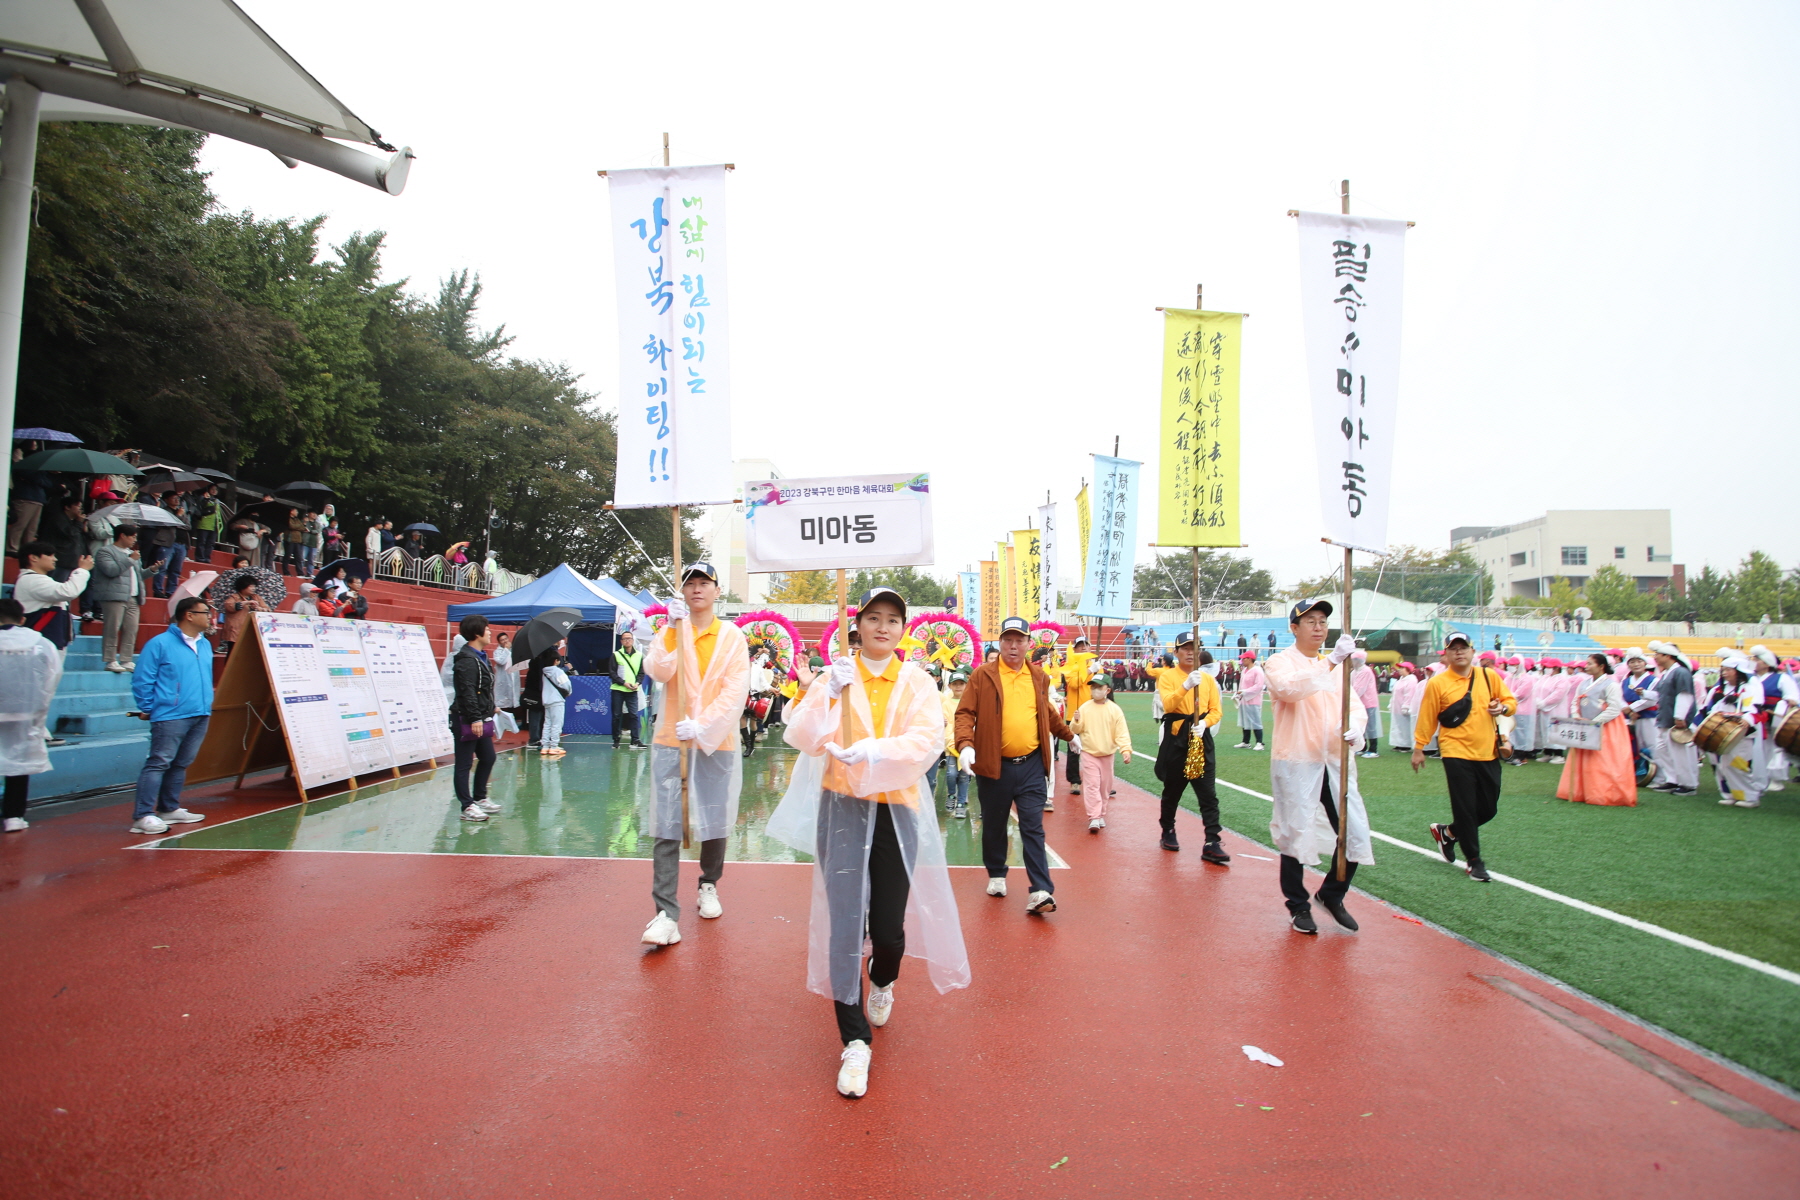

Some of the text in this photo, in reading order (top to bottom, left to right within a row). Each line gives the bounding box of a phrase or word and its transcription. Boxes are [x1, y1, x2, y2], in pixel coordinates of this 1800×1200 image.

[630, 197, 674, 315] 강북
[1337, 368, 1370, 519] 미아동
[780, 488, 802, 498] 2023
[803, 486, 835, 497] 강북구민
[836, 485, 860, 496] 한마음
[862, 484, 894, 494] 체육대회
[800, 514, 878, 545] 미아동
